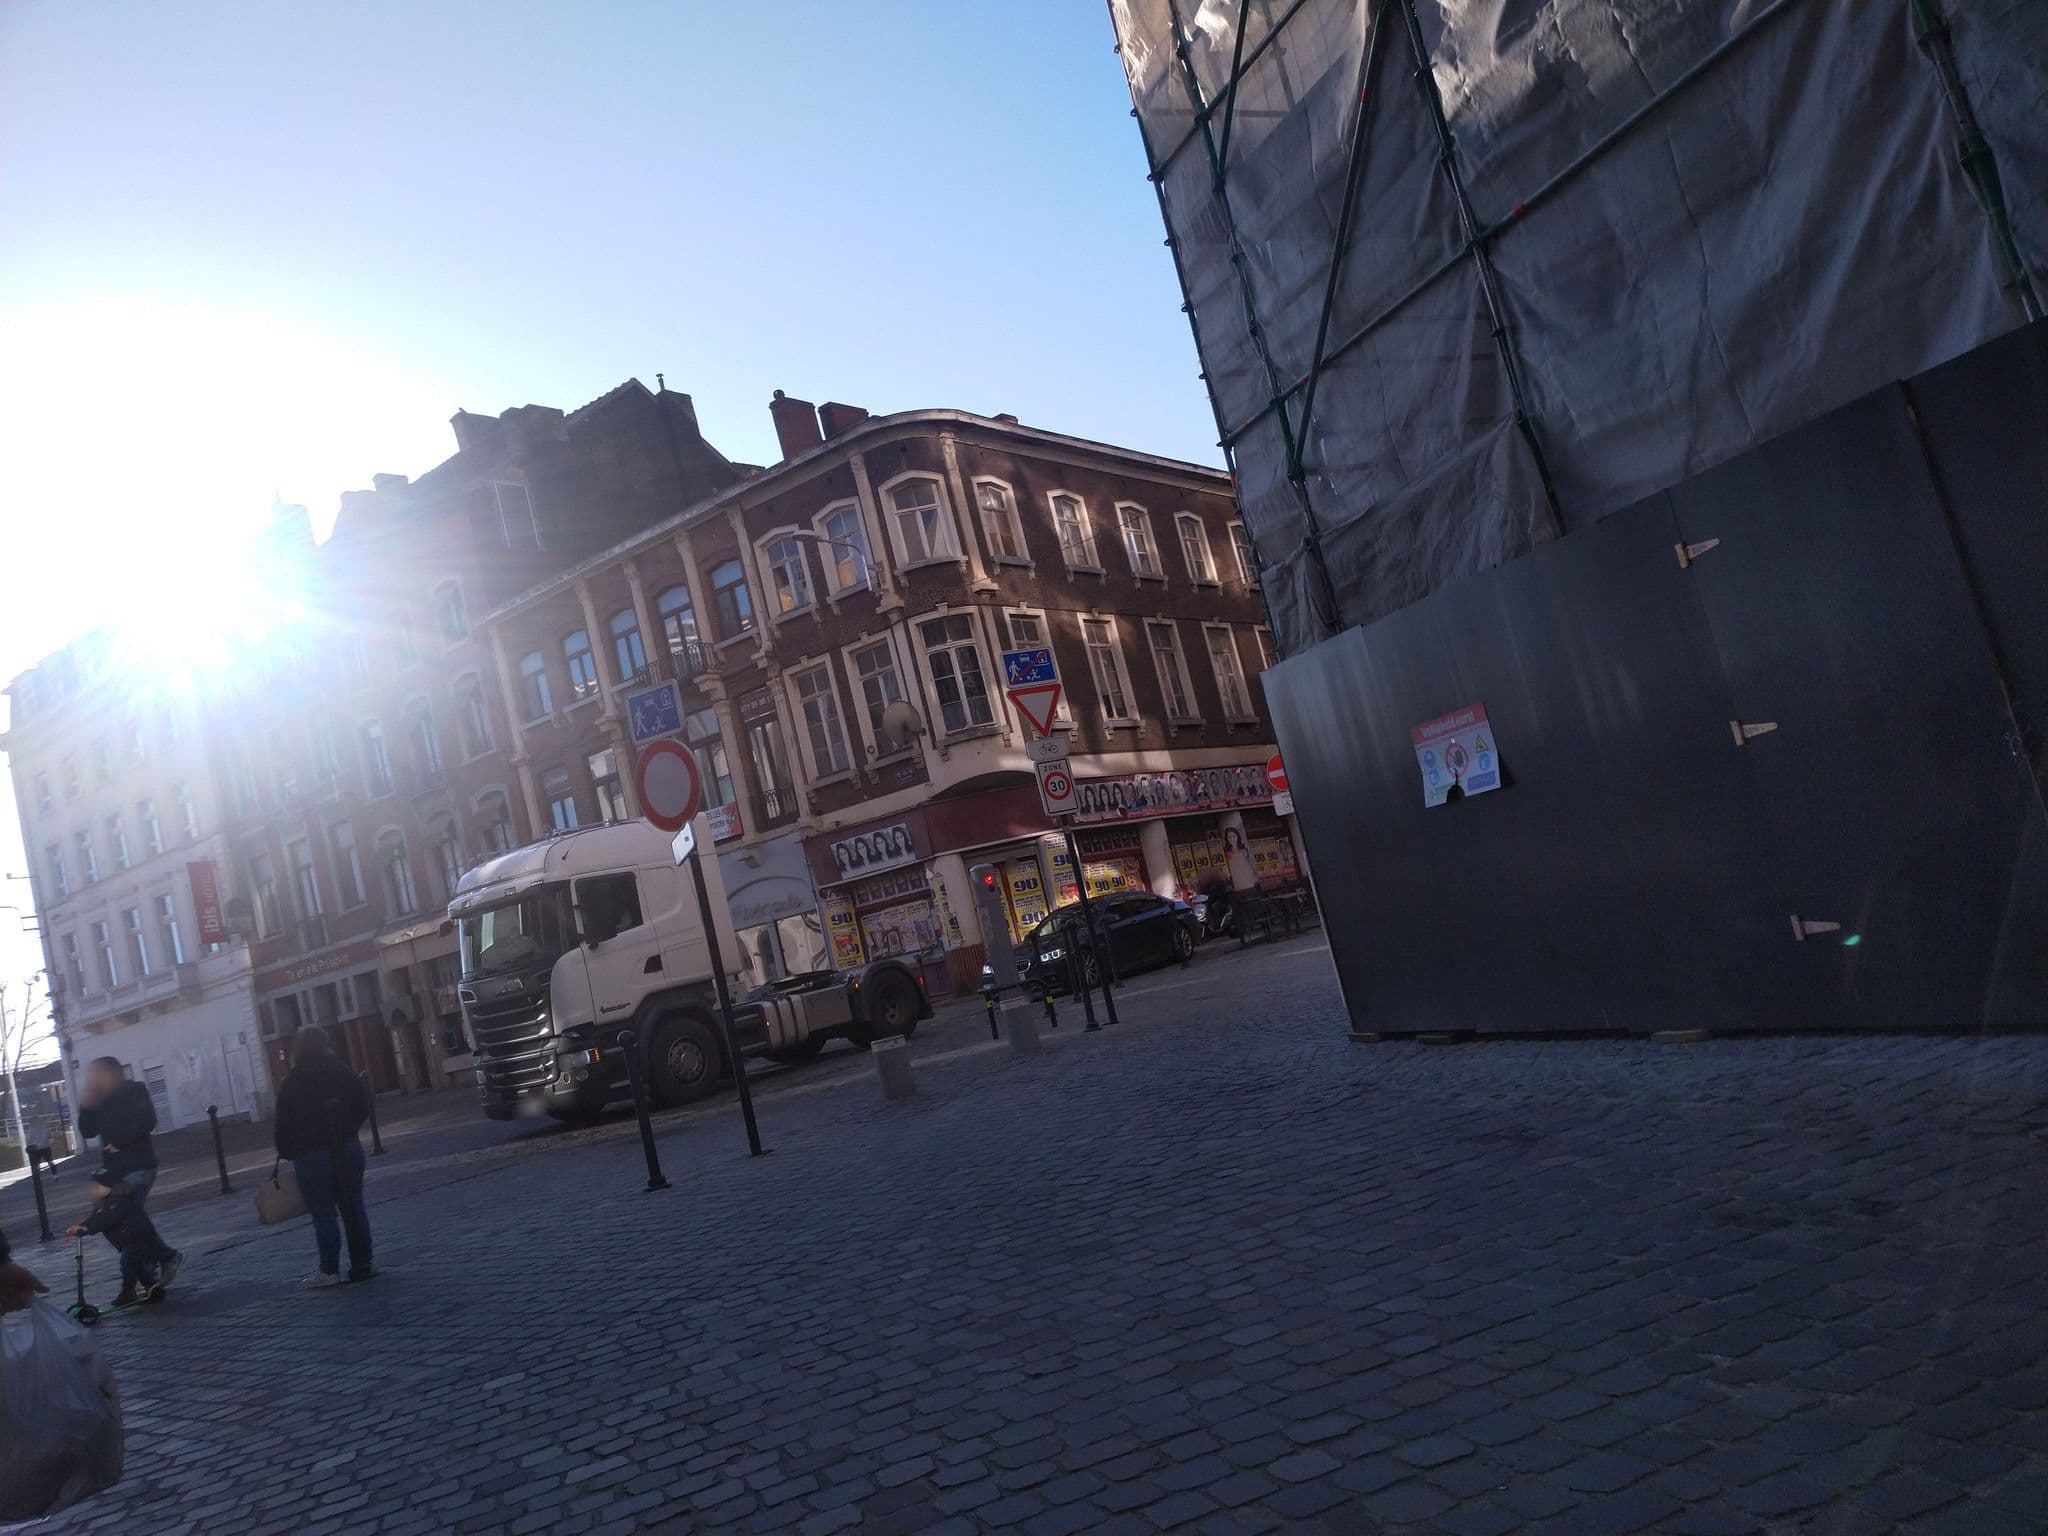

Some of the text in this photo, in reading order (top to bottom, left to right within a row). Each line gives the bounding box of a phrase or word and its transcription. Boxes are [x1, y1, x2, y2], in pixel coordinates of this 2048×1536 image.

[1043, 763, 1063, 772] ZONE
[1049, 780, 1066, 792] 30
[1213, 853, 1225, 864] 90
[1254, 853, 1265, 863] 90
[1266, 851, 1279, 861] 90
[1182, 859, 1193, 870] 90
[1198, 857, 1209, 867] 90
[1014, 878, 1038, 892] 90
[1095, 880, 1110, 892] 90
[1111, 876, 1126, 887] 90
[204, 905, 220, 934] ibis
[831, 912, 853, 926] 90
[1021, 911, 1045, 925] 90
